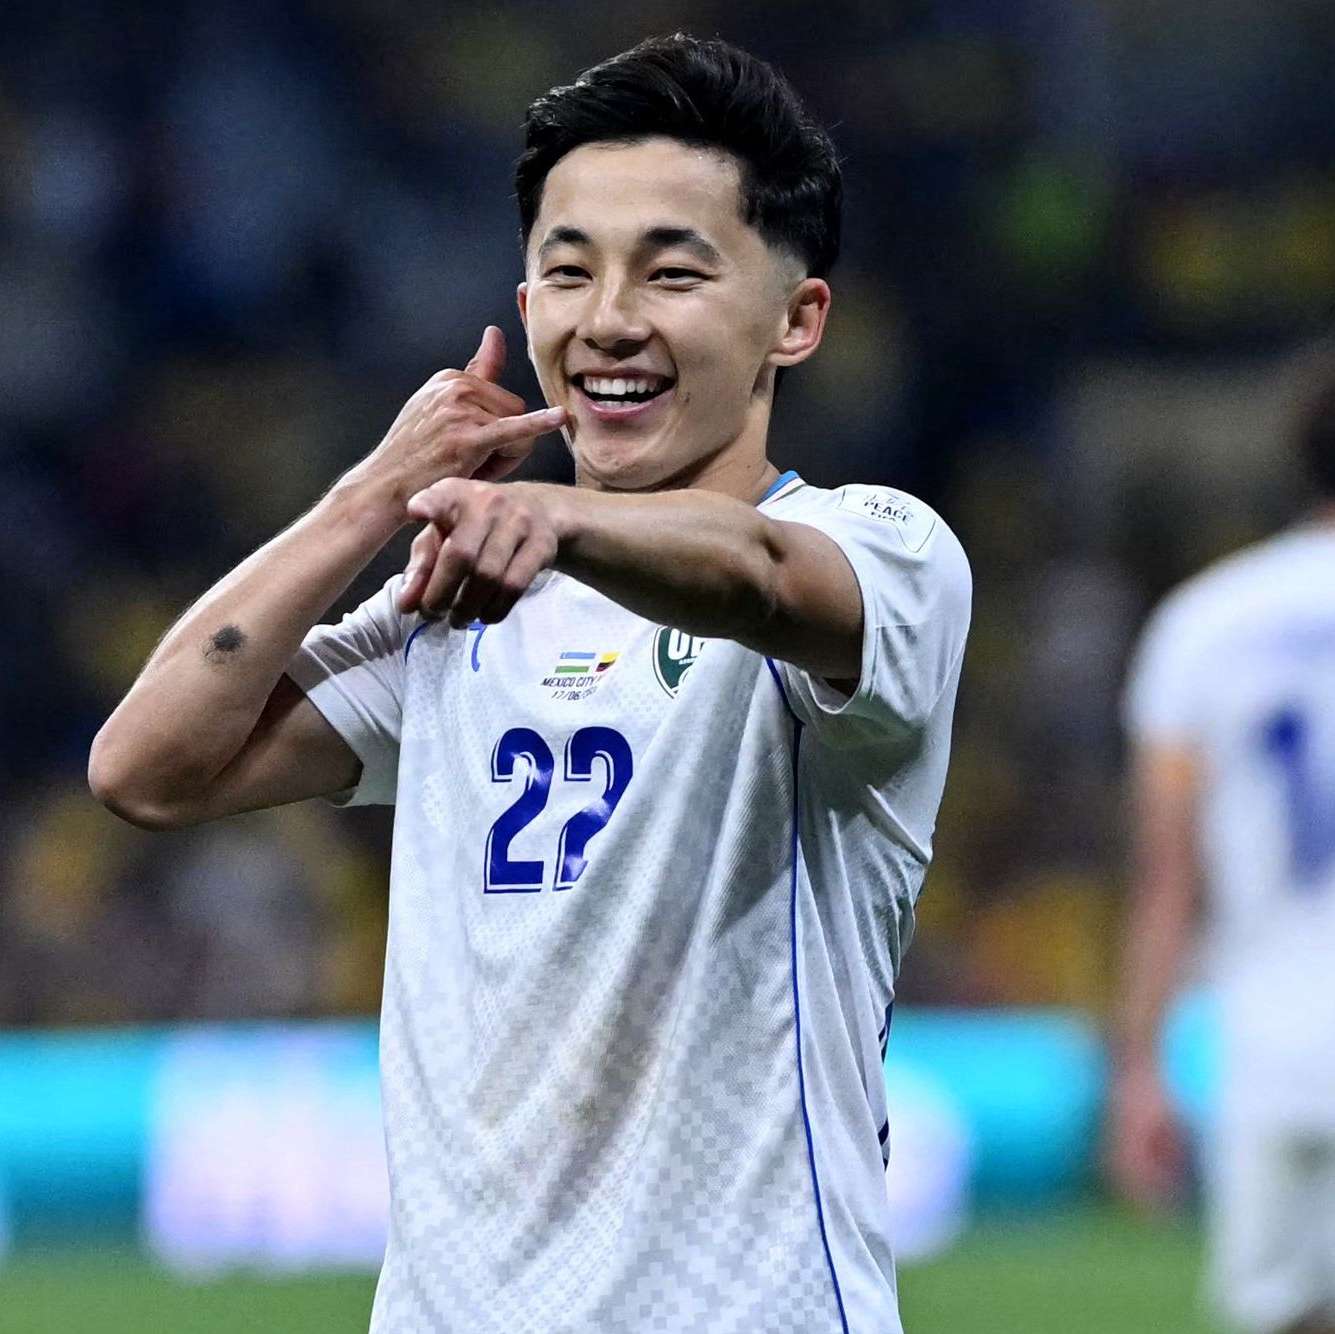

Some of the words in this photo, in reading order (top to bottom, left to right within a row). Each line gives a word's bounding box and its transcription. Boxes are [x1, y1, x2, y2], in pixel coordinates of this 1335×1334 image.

[541, 677, 576, 687] MEXICO
[576, 676, 595, 687] CITY
[483, 726, 634, 895] 22
